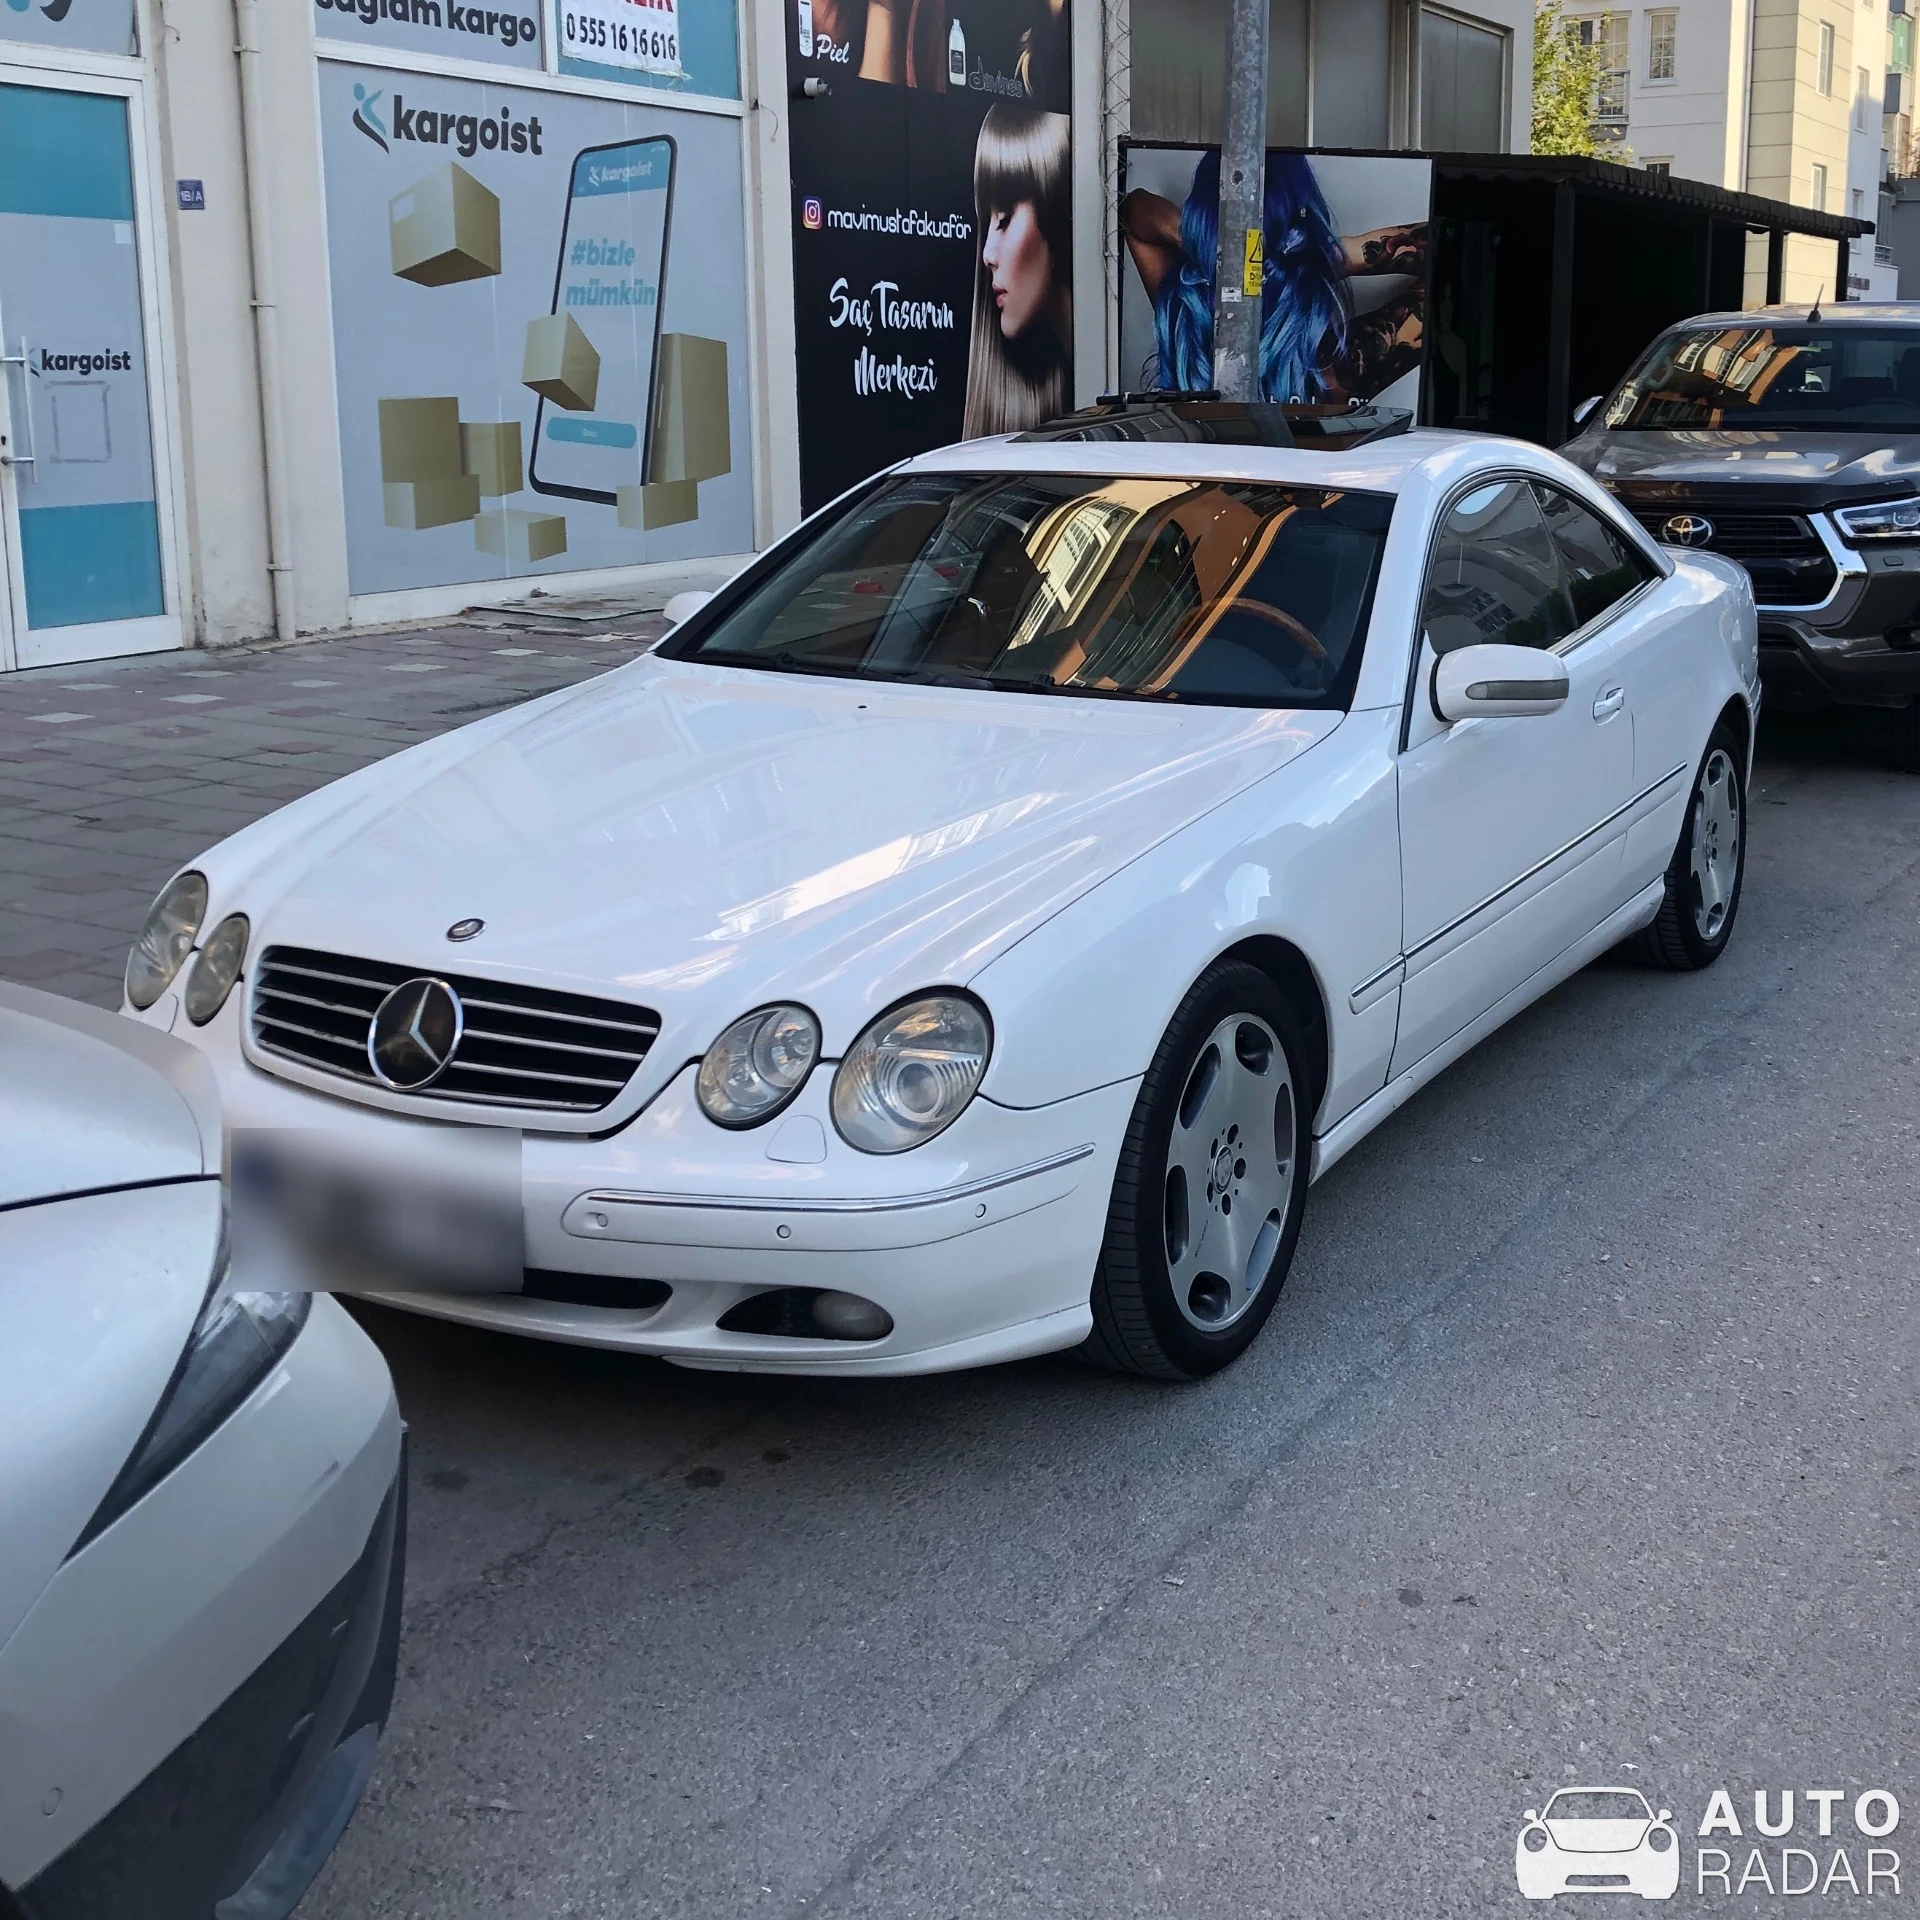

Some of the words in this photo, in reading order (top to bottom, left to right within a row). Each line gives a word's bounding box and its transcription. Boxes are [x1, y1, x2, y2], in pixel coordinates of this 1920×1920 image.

[447, 0, 537, 47] kargo
[566, 12, 576, 41] 0
[579, 15, 606, 47] 555
[610, 22, 628, 52] 16
[631, 27, 648, 56] 16
[651, 31, 676, 60] 616
[816, 34, 850, 64] Piel
[393, 95, 543, 158] kargoist
[600, 160, 653, 183] kargoist
[827, 203, 972, 240] mavimustafakuaför
[571, 238, 636, 266] #bizle
[565, 277, 656, 306] mümkün
[829, 277, 874, 337] Saç
[870, 280, 954, 330] Tasarım
[41, 347, 131, 376] kargoist
[854, 345, 938, 400] Merkezi
